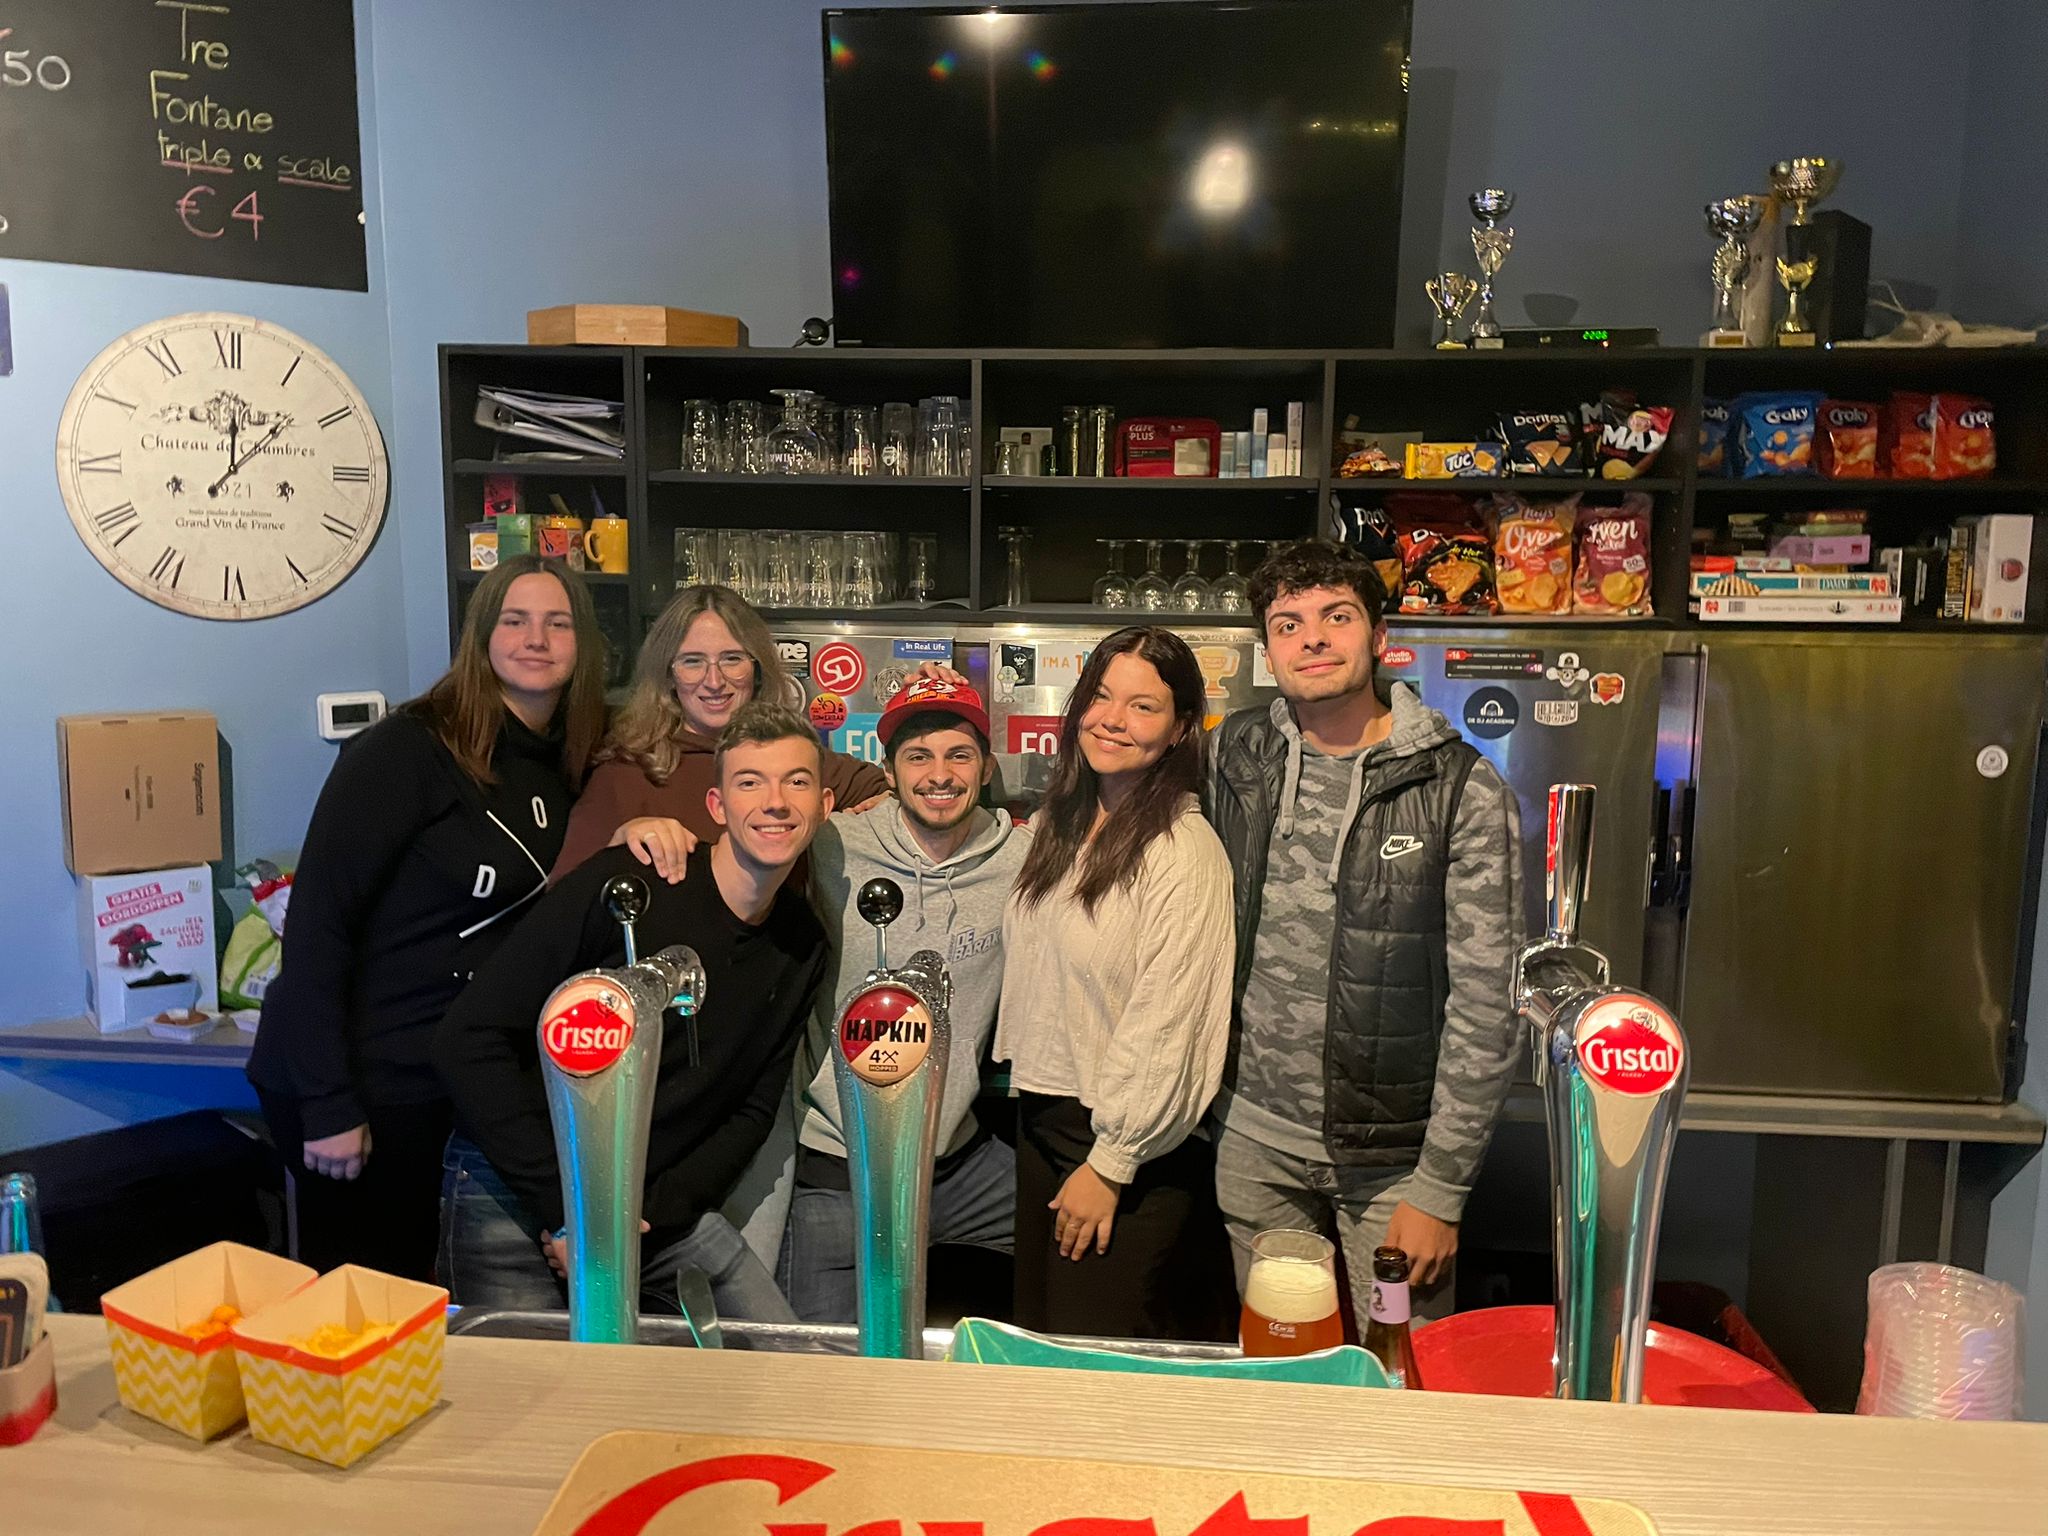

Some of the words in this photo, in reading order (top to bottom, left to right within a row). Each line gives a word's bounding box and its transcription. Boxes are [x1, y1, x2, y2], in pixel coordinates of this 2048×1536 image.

[155, 1, 230, 70] Tre
[150, 70, 274, 134] Fontane
[158, 129, 231, 176] triple
[278, 155, 350, 182] scale
[214, 330, 244, 369] XII
[1513, 414, 1568, 427] Doritos
[1765, 407, 1808, 424] Croky
[1829, 408, 1868, 425] Croky
[141, 433, 209, 452] Chateau
[1129, 432, 1154, 441] PLUS
[1602, 423, 1667, 453] MAX
[769, 453, 803, 463] CHIMA
[1446, 454, 1471, 471] TUC
[332, 466, 370, 481] III
[175, 518, 210, 528] Grand
[213, 519, 232, 528] Vin
[235, 519, 247, 529] de
[251, 520, 285, 530] France
[1822, 578, 1858, 590] DAMM
[905, 642, 913, 650] In
[914, 642, 931, 651] Real
[933, 643, 946, 651] Life
[1042, 656, 1059, 668] I'M
[1062, 656, 1070, 668] A
[1389, 838, 1412, 848] NIKE
[111, 885, 157, 906] GRATIS
[956, 928, 975, 948] DE
[546, 1017, 628, 1054] Cristal
[846, 1019, 927, 1043] HAPKIN
[1585, 1038, 1674, 1076] Cristal
